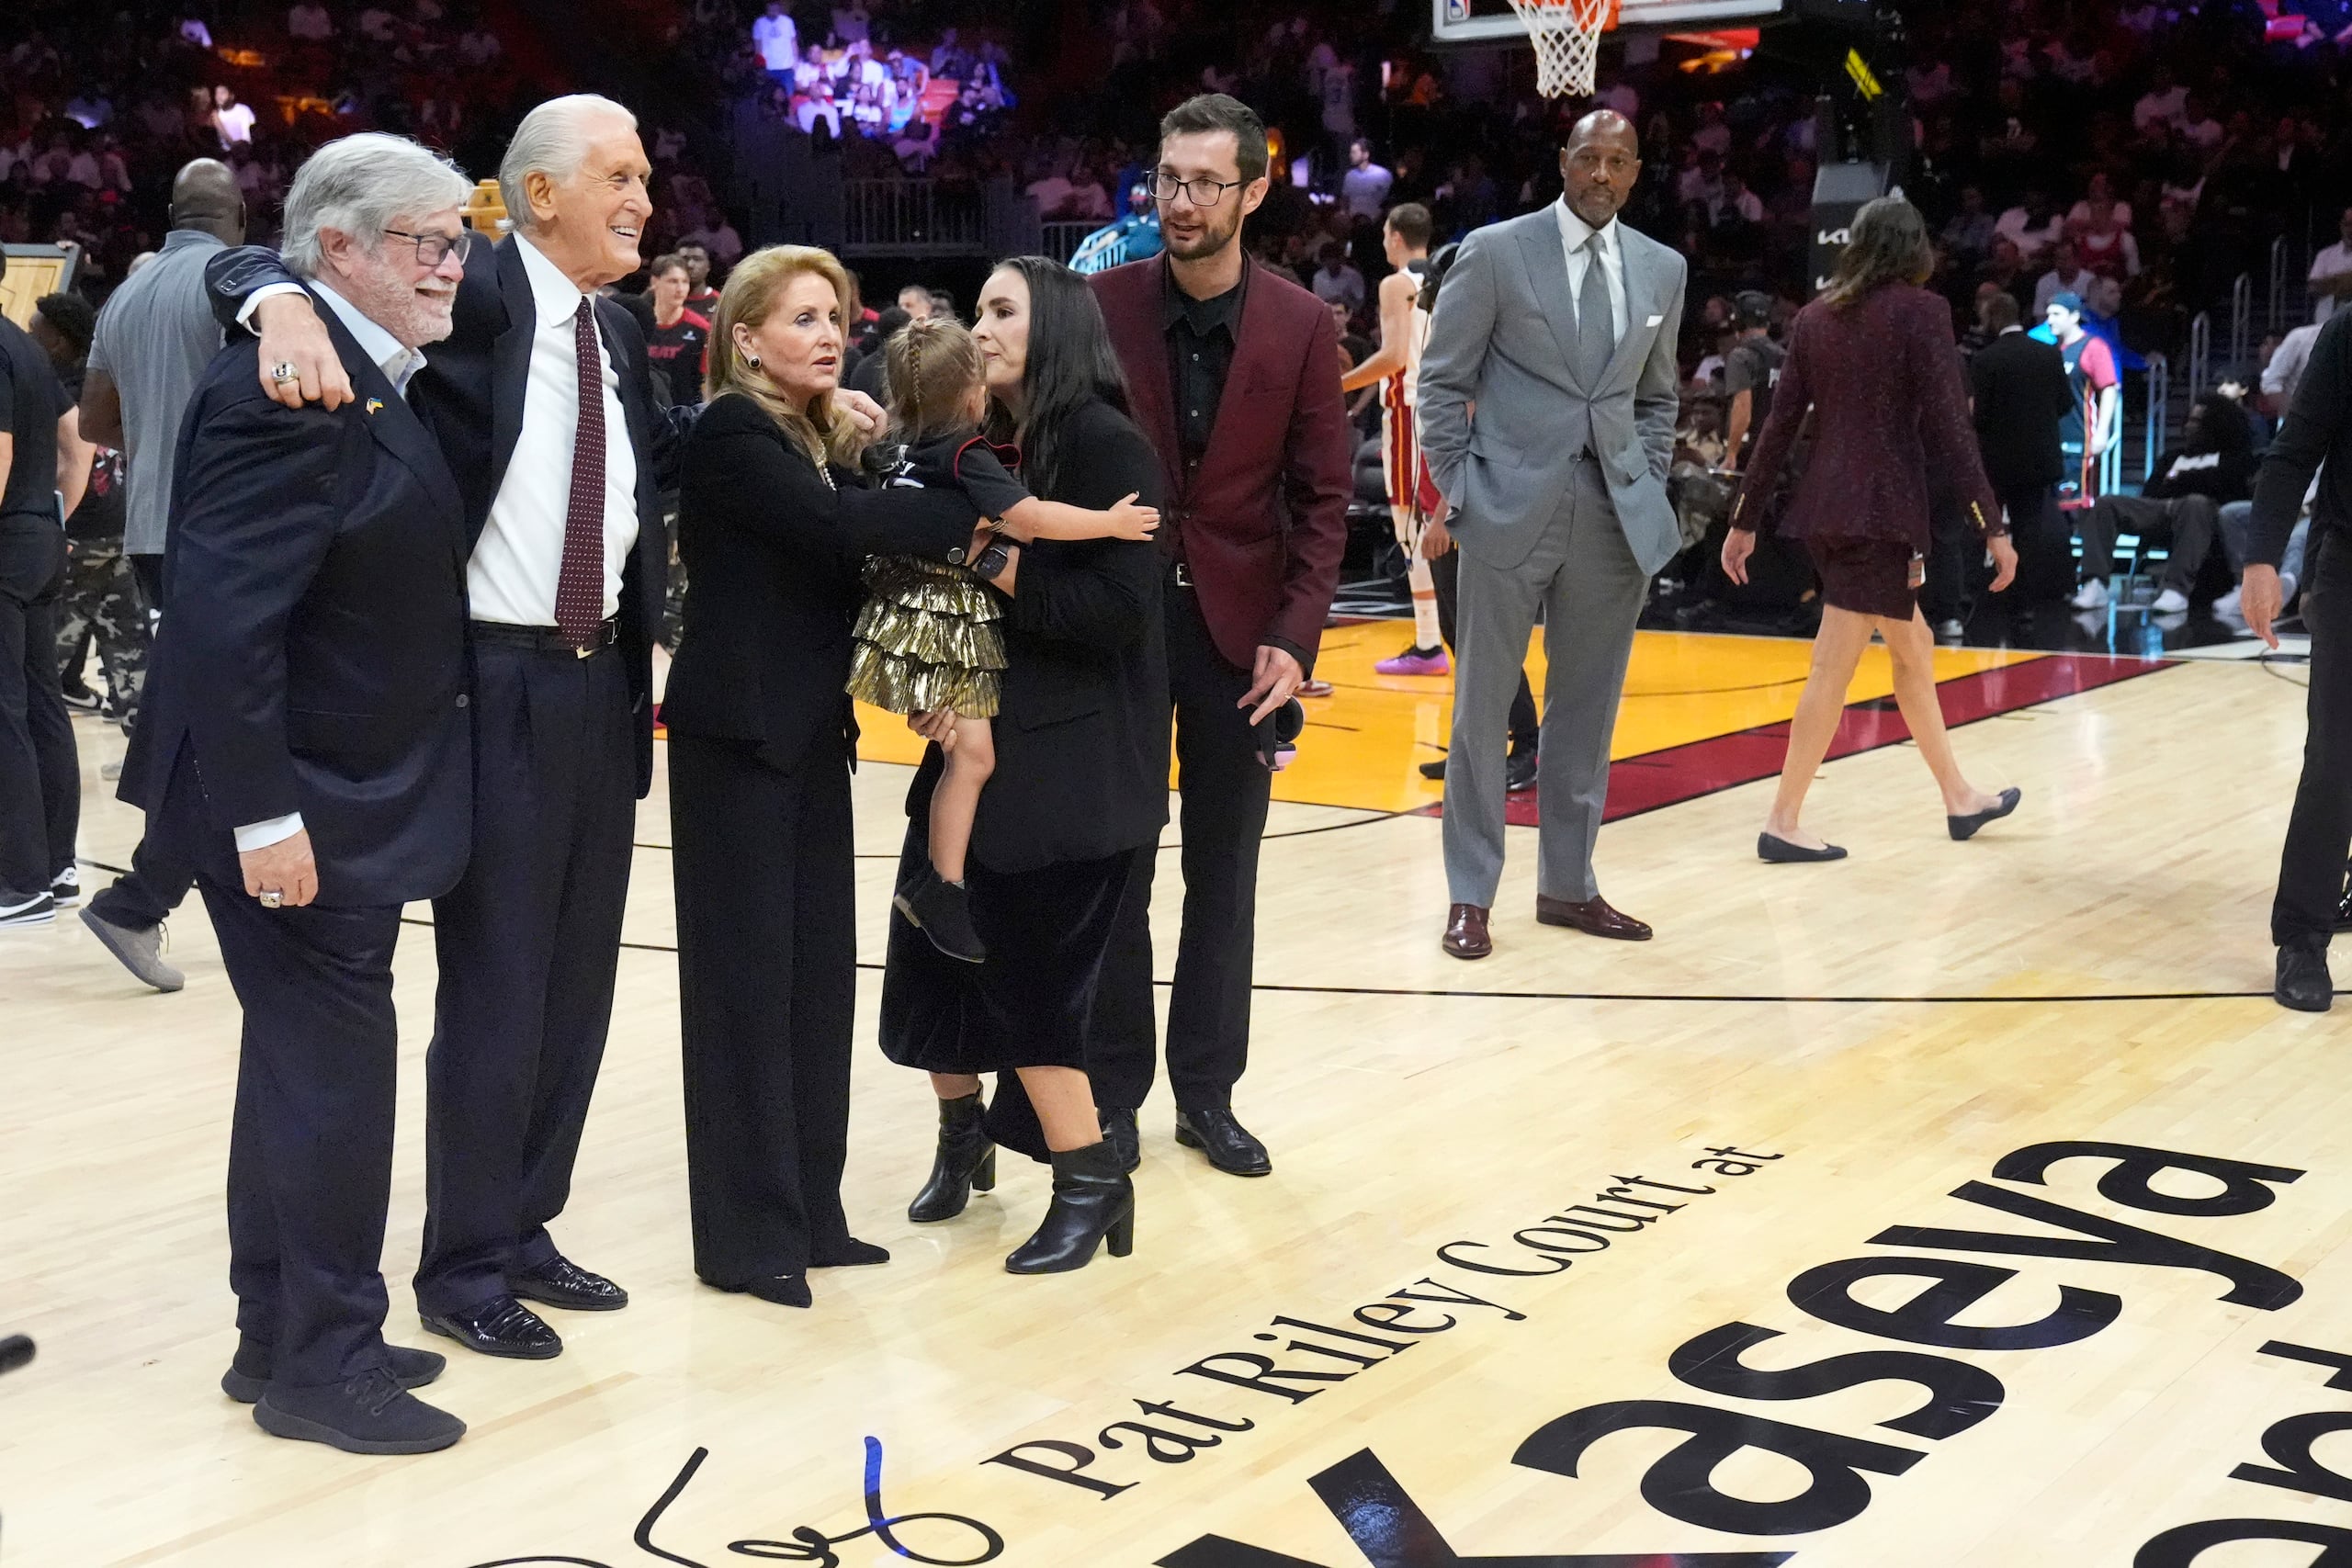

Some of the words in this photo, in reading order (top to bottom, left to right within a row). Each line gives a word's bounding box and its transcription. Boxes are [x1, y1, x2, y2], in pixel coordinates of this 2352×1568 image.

[647, 343, 685, 359] EAT
[978, 1398, 1255, 1501] Pat
[1172, 1277, 1528, 1405] Riley
[1436, 1174, 1716, 1277] Court
[1691, 1145, 1785, 1177] at
